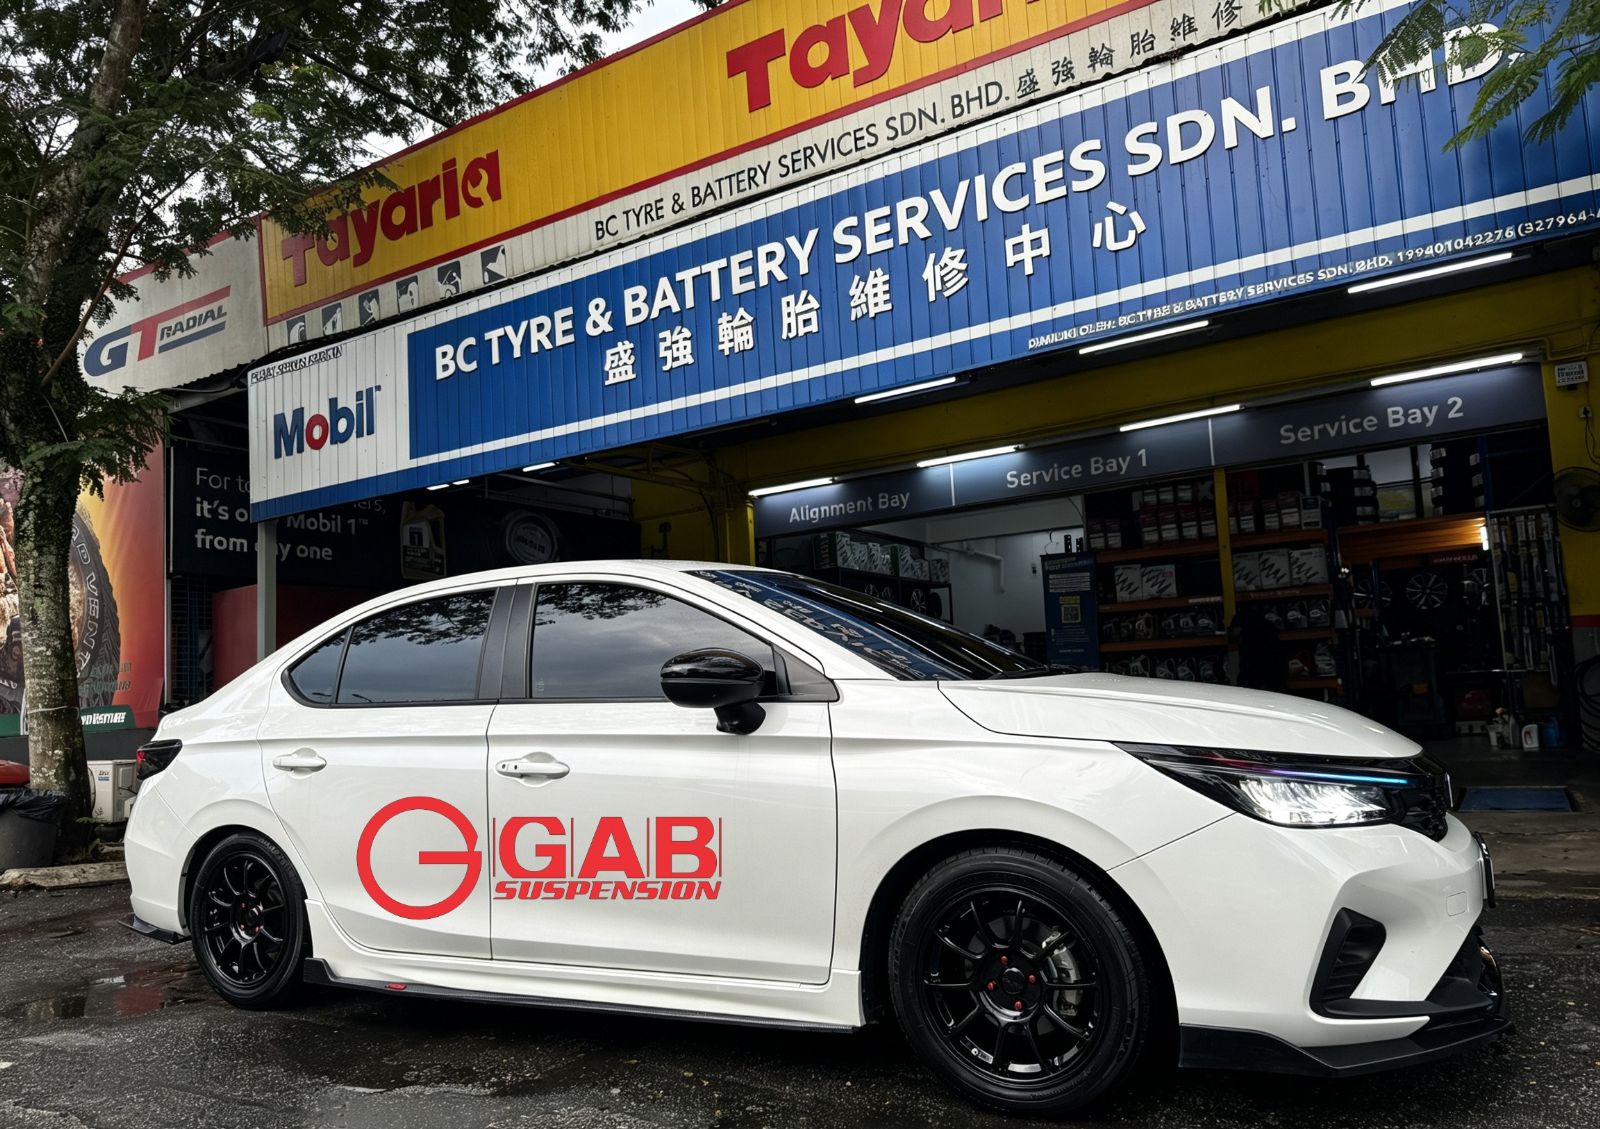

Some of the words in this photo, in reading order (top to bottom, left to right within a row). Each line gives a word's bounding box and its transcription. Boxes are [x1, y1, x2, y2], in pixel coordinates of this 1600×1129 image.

[726, 0, 1039, 113] Taya
[595, 214, 618, 241] BC
[623, 198, 665, 231] TYRE
[671, 192, 685, 214] &
[691, 161, 771, 208] BATTERY
[778, 123, 880, 177] SERVICES
[885, 102, 945, 141] SDN.
[951, 79, 1010, 118] BHD.
[282, 149, 502, 288] Tayaria
[435, 336, 478, 381] BC
[484, 306, 575, 365] TYRE
[585, 297, 614, 337] &
[624, 228, 819, 327] BATTERY
[833, 139, 1106, 264] SERVICES
[1124, 86, 1297, 176] SDN.
[603, 201, 1147, 386] 盛強輪胎維修中心
[84, 285, 231, 377] GT
[160, 305, 227, 341] RADIAL
[273, 386, 375, 459] Mobil
[1279, 414, 1378, 446] Service
[1387, 403, 1438, 429] Bay
[1447, 396, 1464, 419] 2
[196, 467, 230, 490] For
[1006, 455, 1082, 488] Service
[1090, 453, 1131, 479] Bay
[1137, 448, 1148, 468] 1
[287, 512, 341, 533] Mobil
[789, 492, 873, 525] Alignment
[878, 490, 910, 510] Bay
[195, 529, 248, 552] from
[296, 544, 333, 560] one
[494, 816, 722, 879] GAB
[493, 880, 722, 900] SUSPENSION
